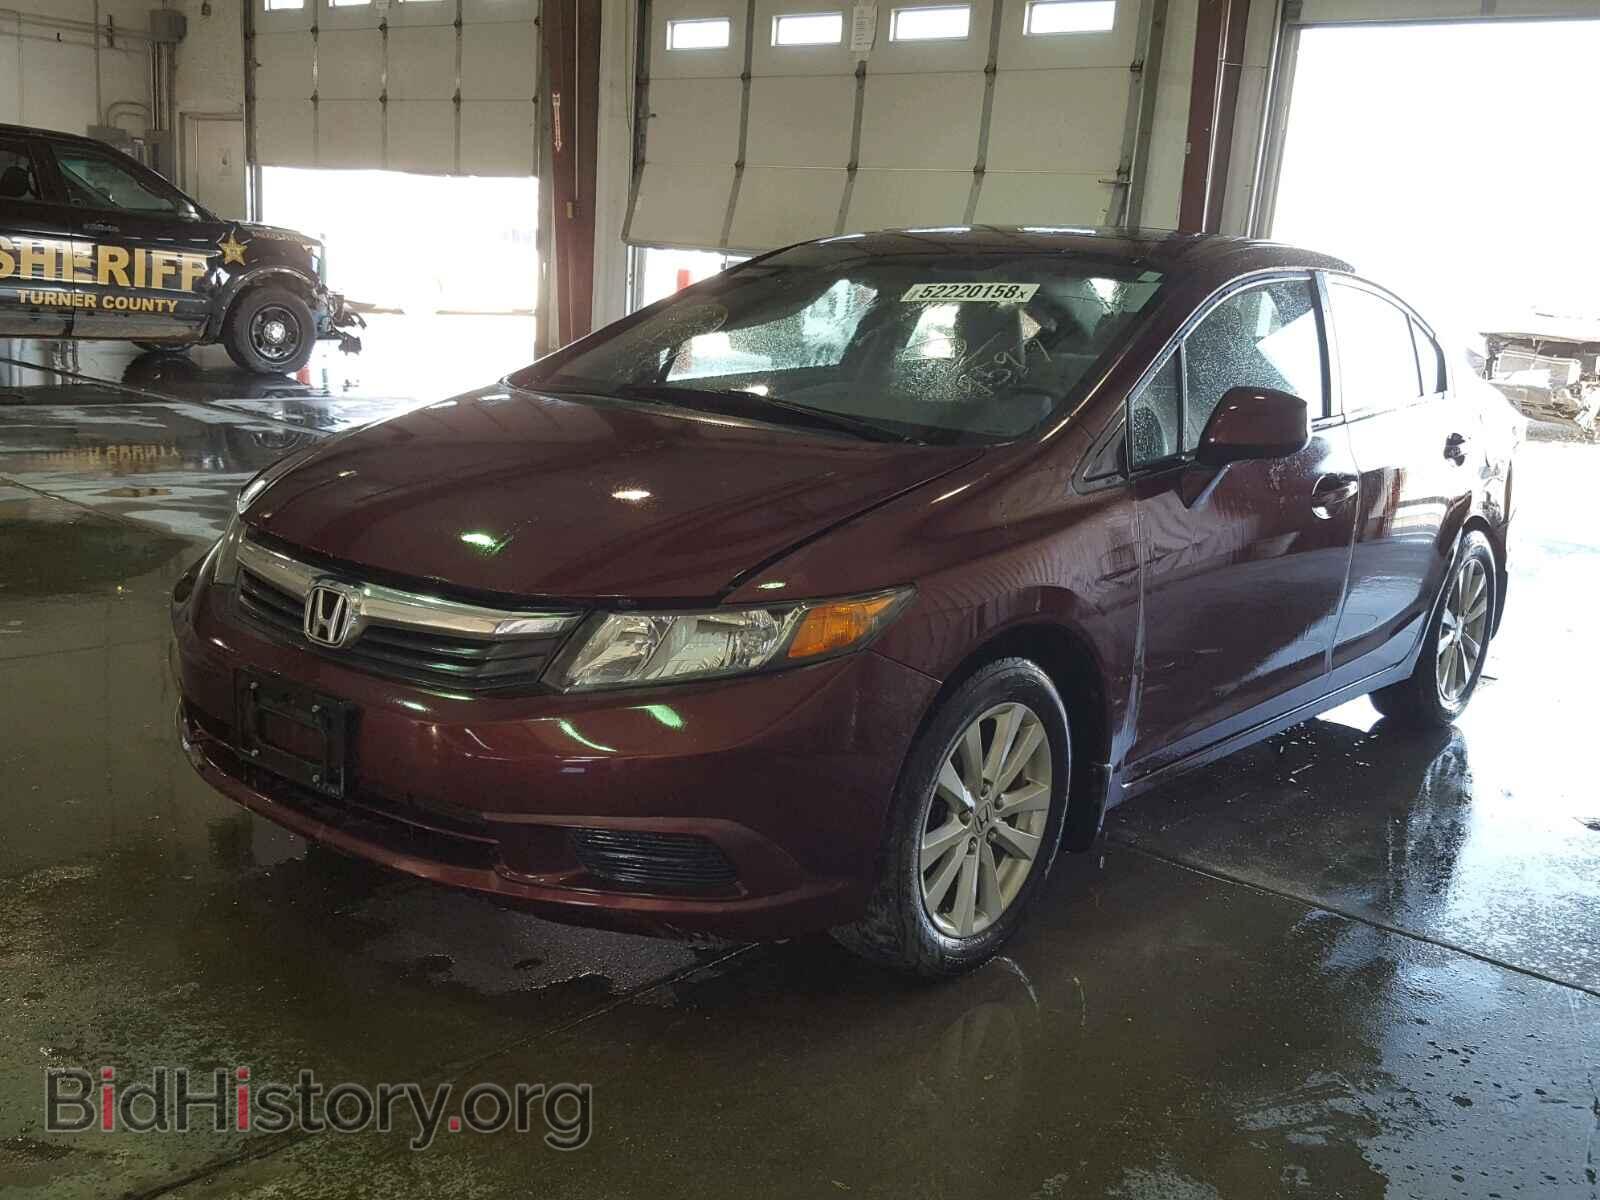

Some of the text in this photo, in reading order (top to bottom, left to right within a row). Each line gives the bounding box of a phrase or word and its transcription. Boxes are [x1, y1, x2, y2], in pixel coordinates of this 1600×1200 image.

[0, 234, 208, 293] SHERIFF
[16, 289, 178, 313] TURNER COUNTY
